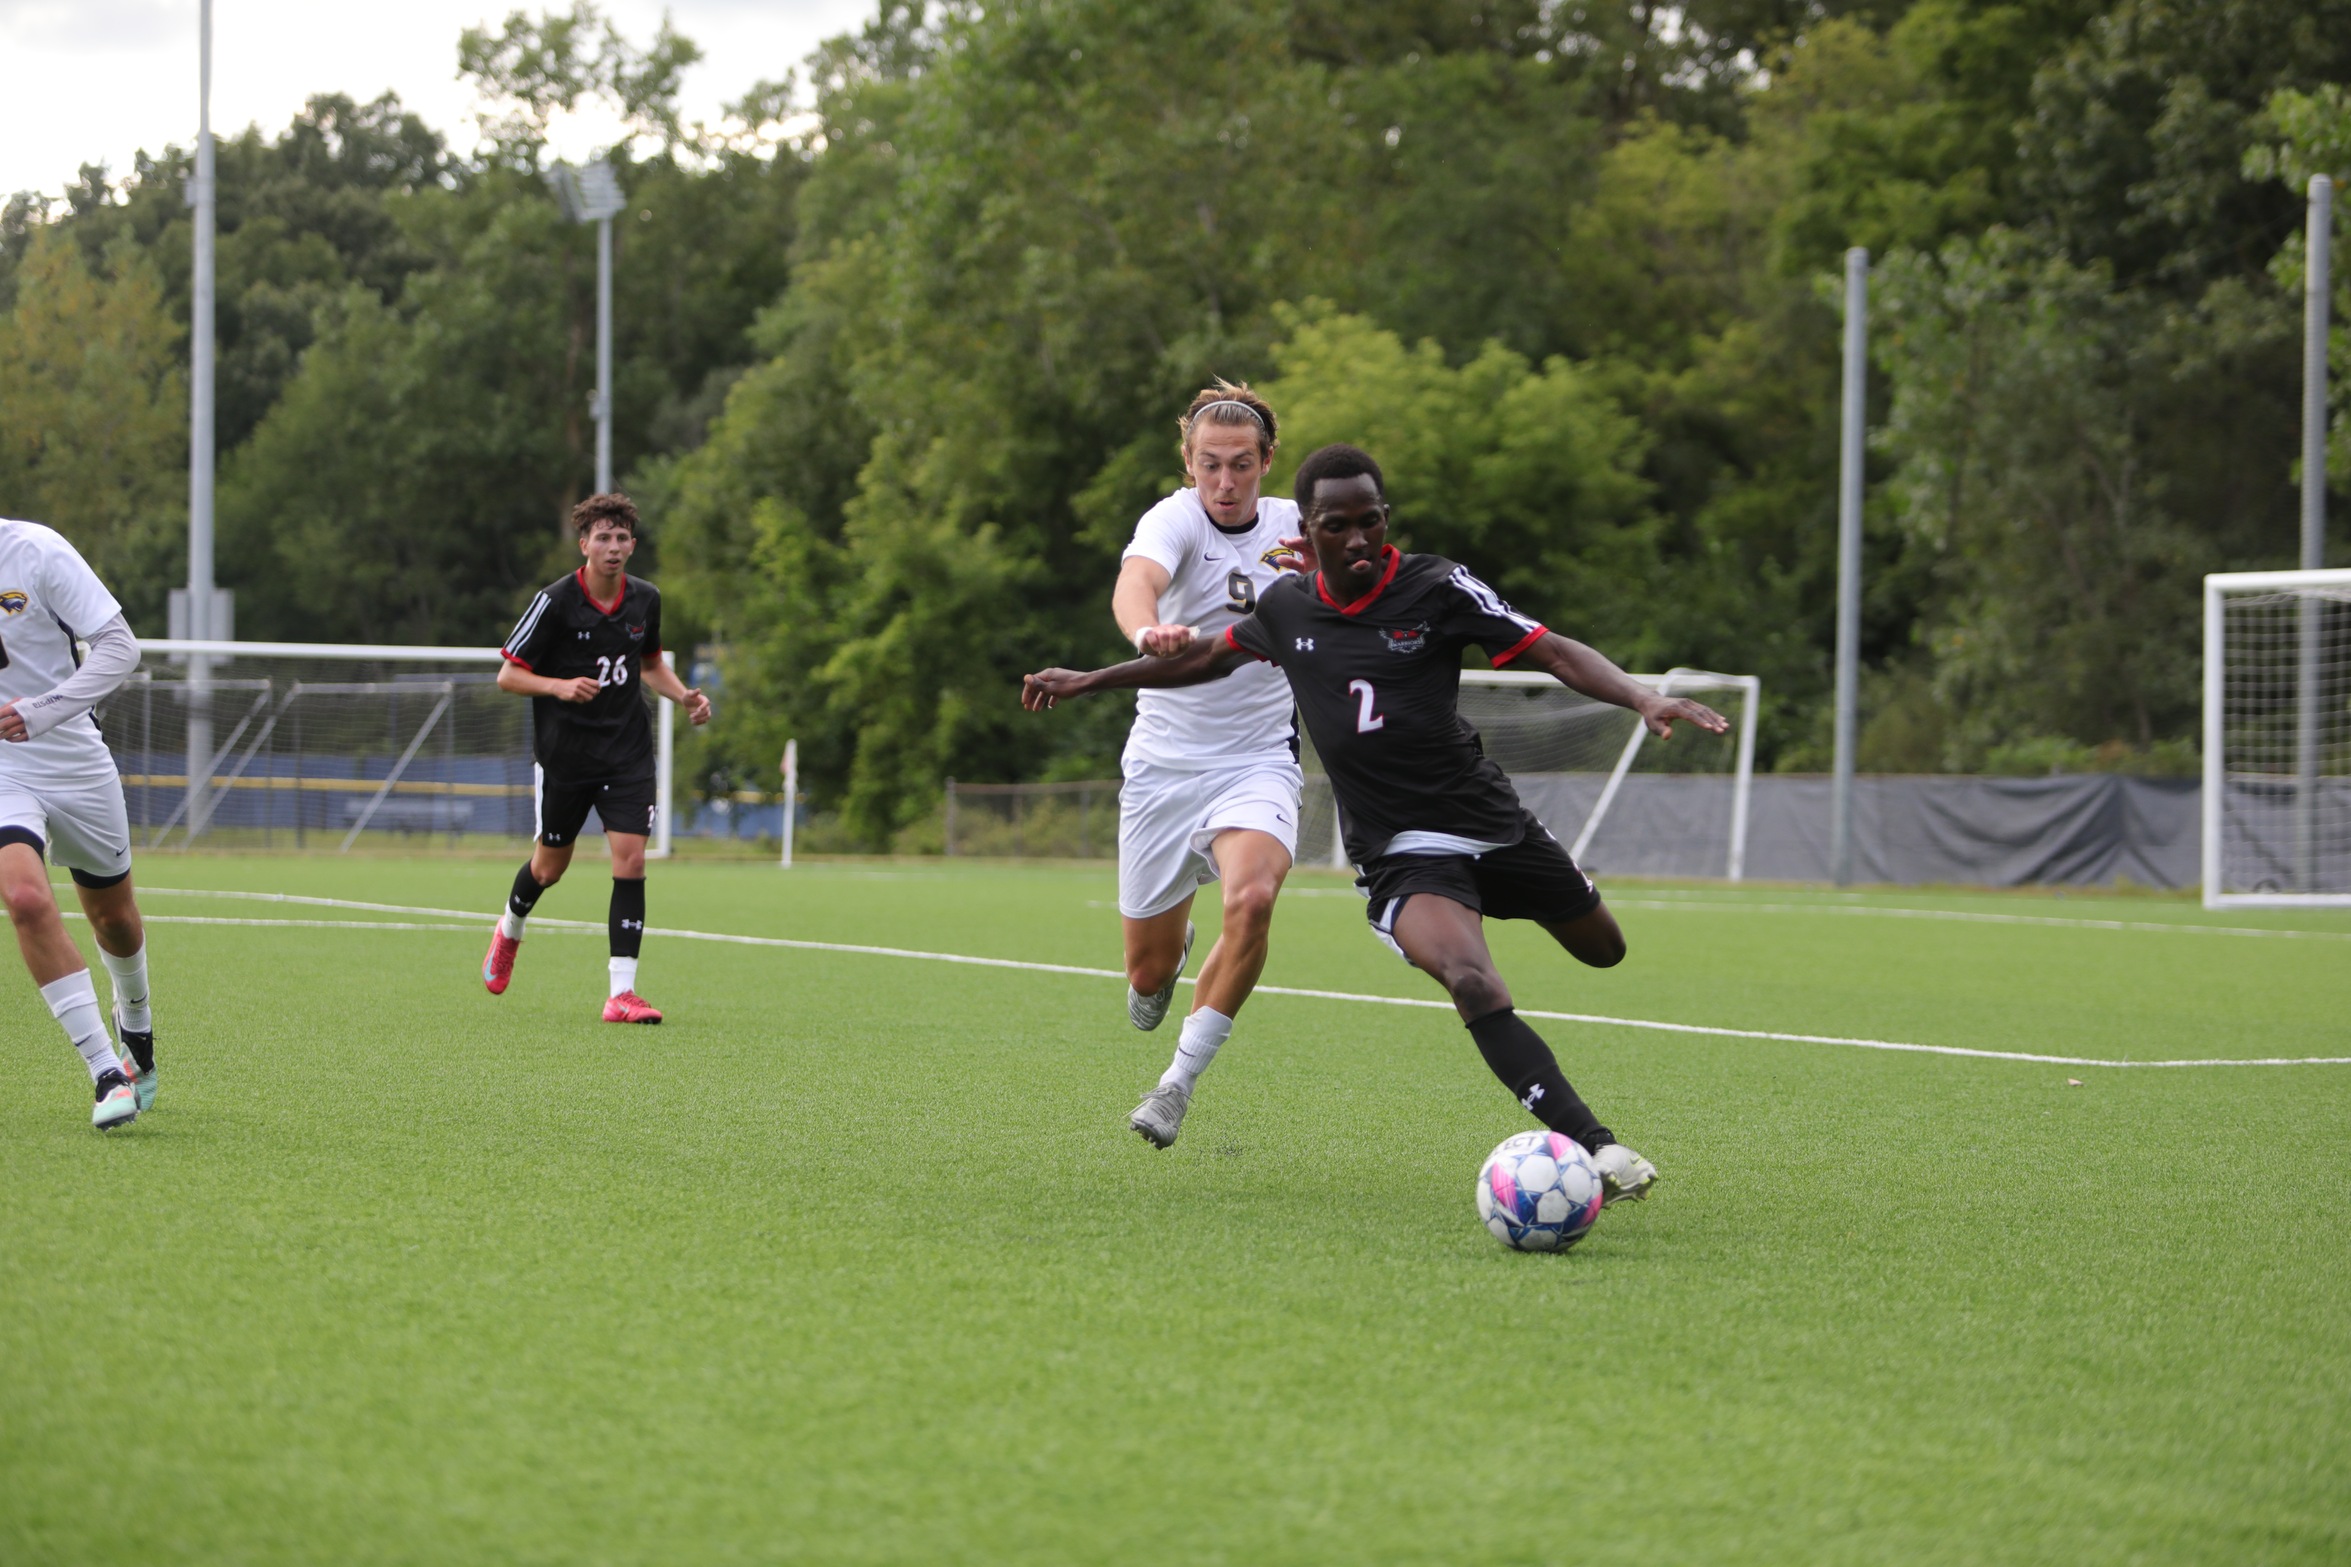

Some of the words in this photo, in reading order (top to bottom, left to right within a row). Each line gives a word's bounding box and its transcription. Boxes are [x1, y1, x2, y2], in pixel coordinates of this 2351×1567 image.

[1225, 572, 1256, 615] 9
[597, 654, 629, 687] 26
[1349, 678, 1384, 733] 2
